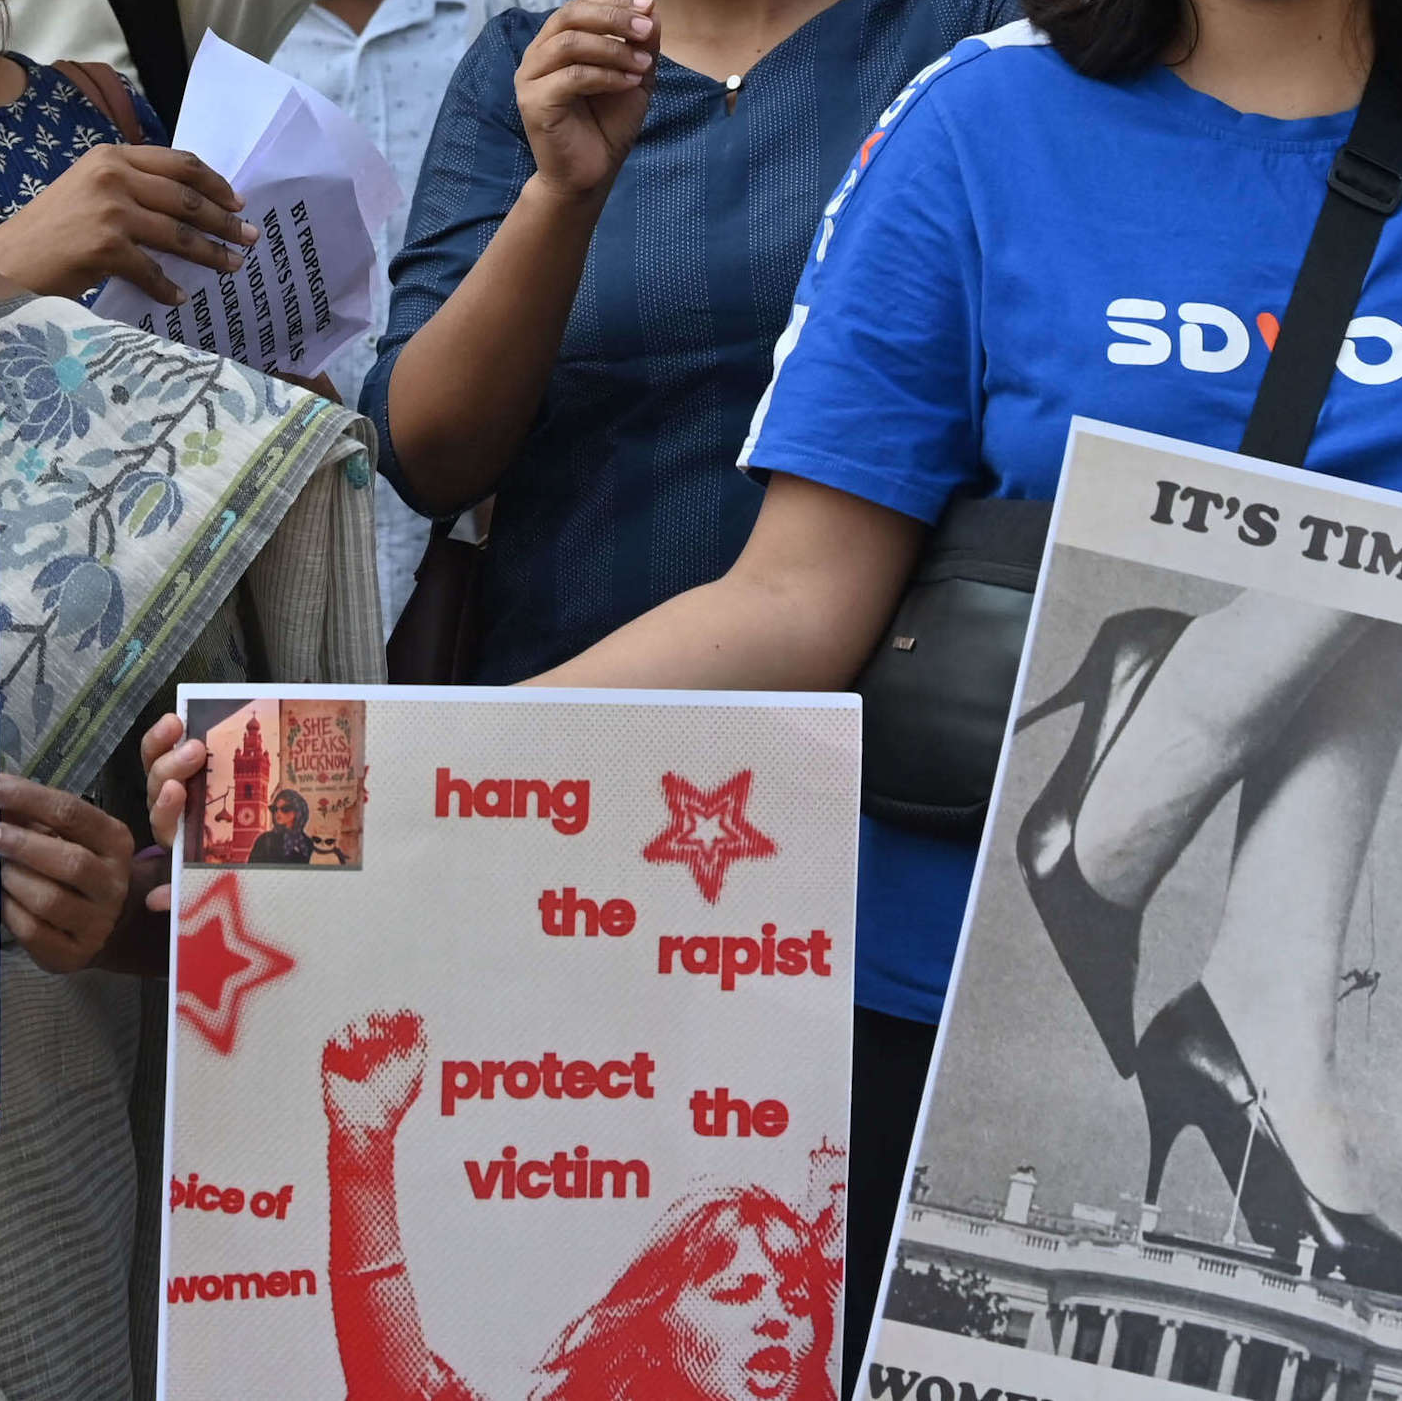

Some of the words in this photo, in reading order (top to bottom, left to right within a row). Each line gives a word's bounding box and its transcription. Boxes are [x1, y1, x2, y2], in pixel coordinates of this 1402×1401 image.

[289, 200, 309, 226] BY
[241, 244, 272, 322] N-VIOLENT
[258, 320, 276, 358] THEY
[262, 206, 293, 285] WOMEN'S
[280, 282, 304, 341] NATURE
[297, 226, 331, 334] PROPAGATING
[191, 286, 212, 334] FROM
[216, 270, 248, 358] COURAGING
[1149, 479, 1281, 547] IT'S
[302, 716, 333, 738] SHE
[293, 754, 352, 773] LUCKNOW
[435, 766, 591, 836] hang
[538, 887, 637, 937] the
[658, 923, 832, 991] rapist
[440, 1052, 655, 1117] protect
[689, 1087, 789, 1138] the
[463, 1145, 650, 1200] victim
[250, 1184, 294, 1220] of
[167, 1269, 317, 1304] women
